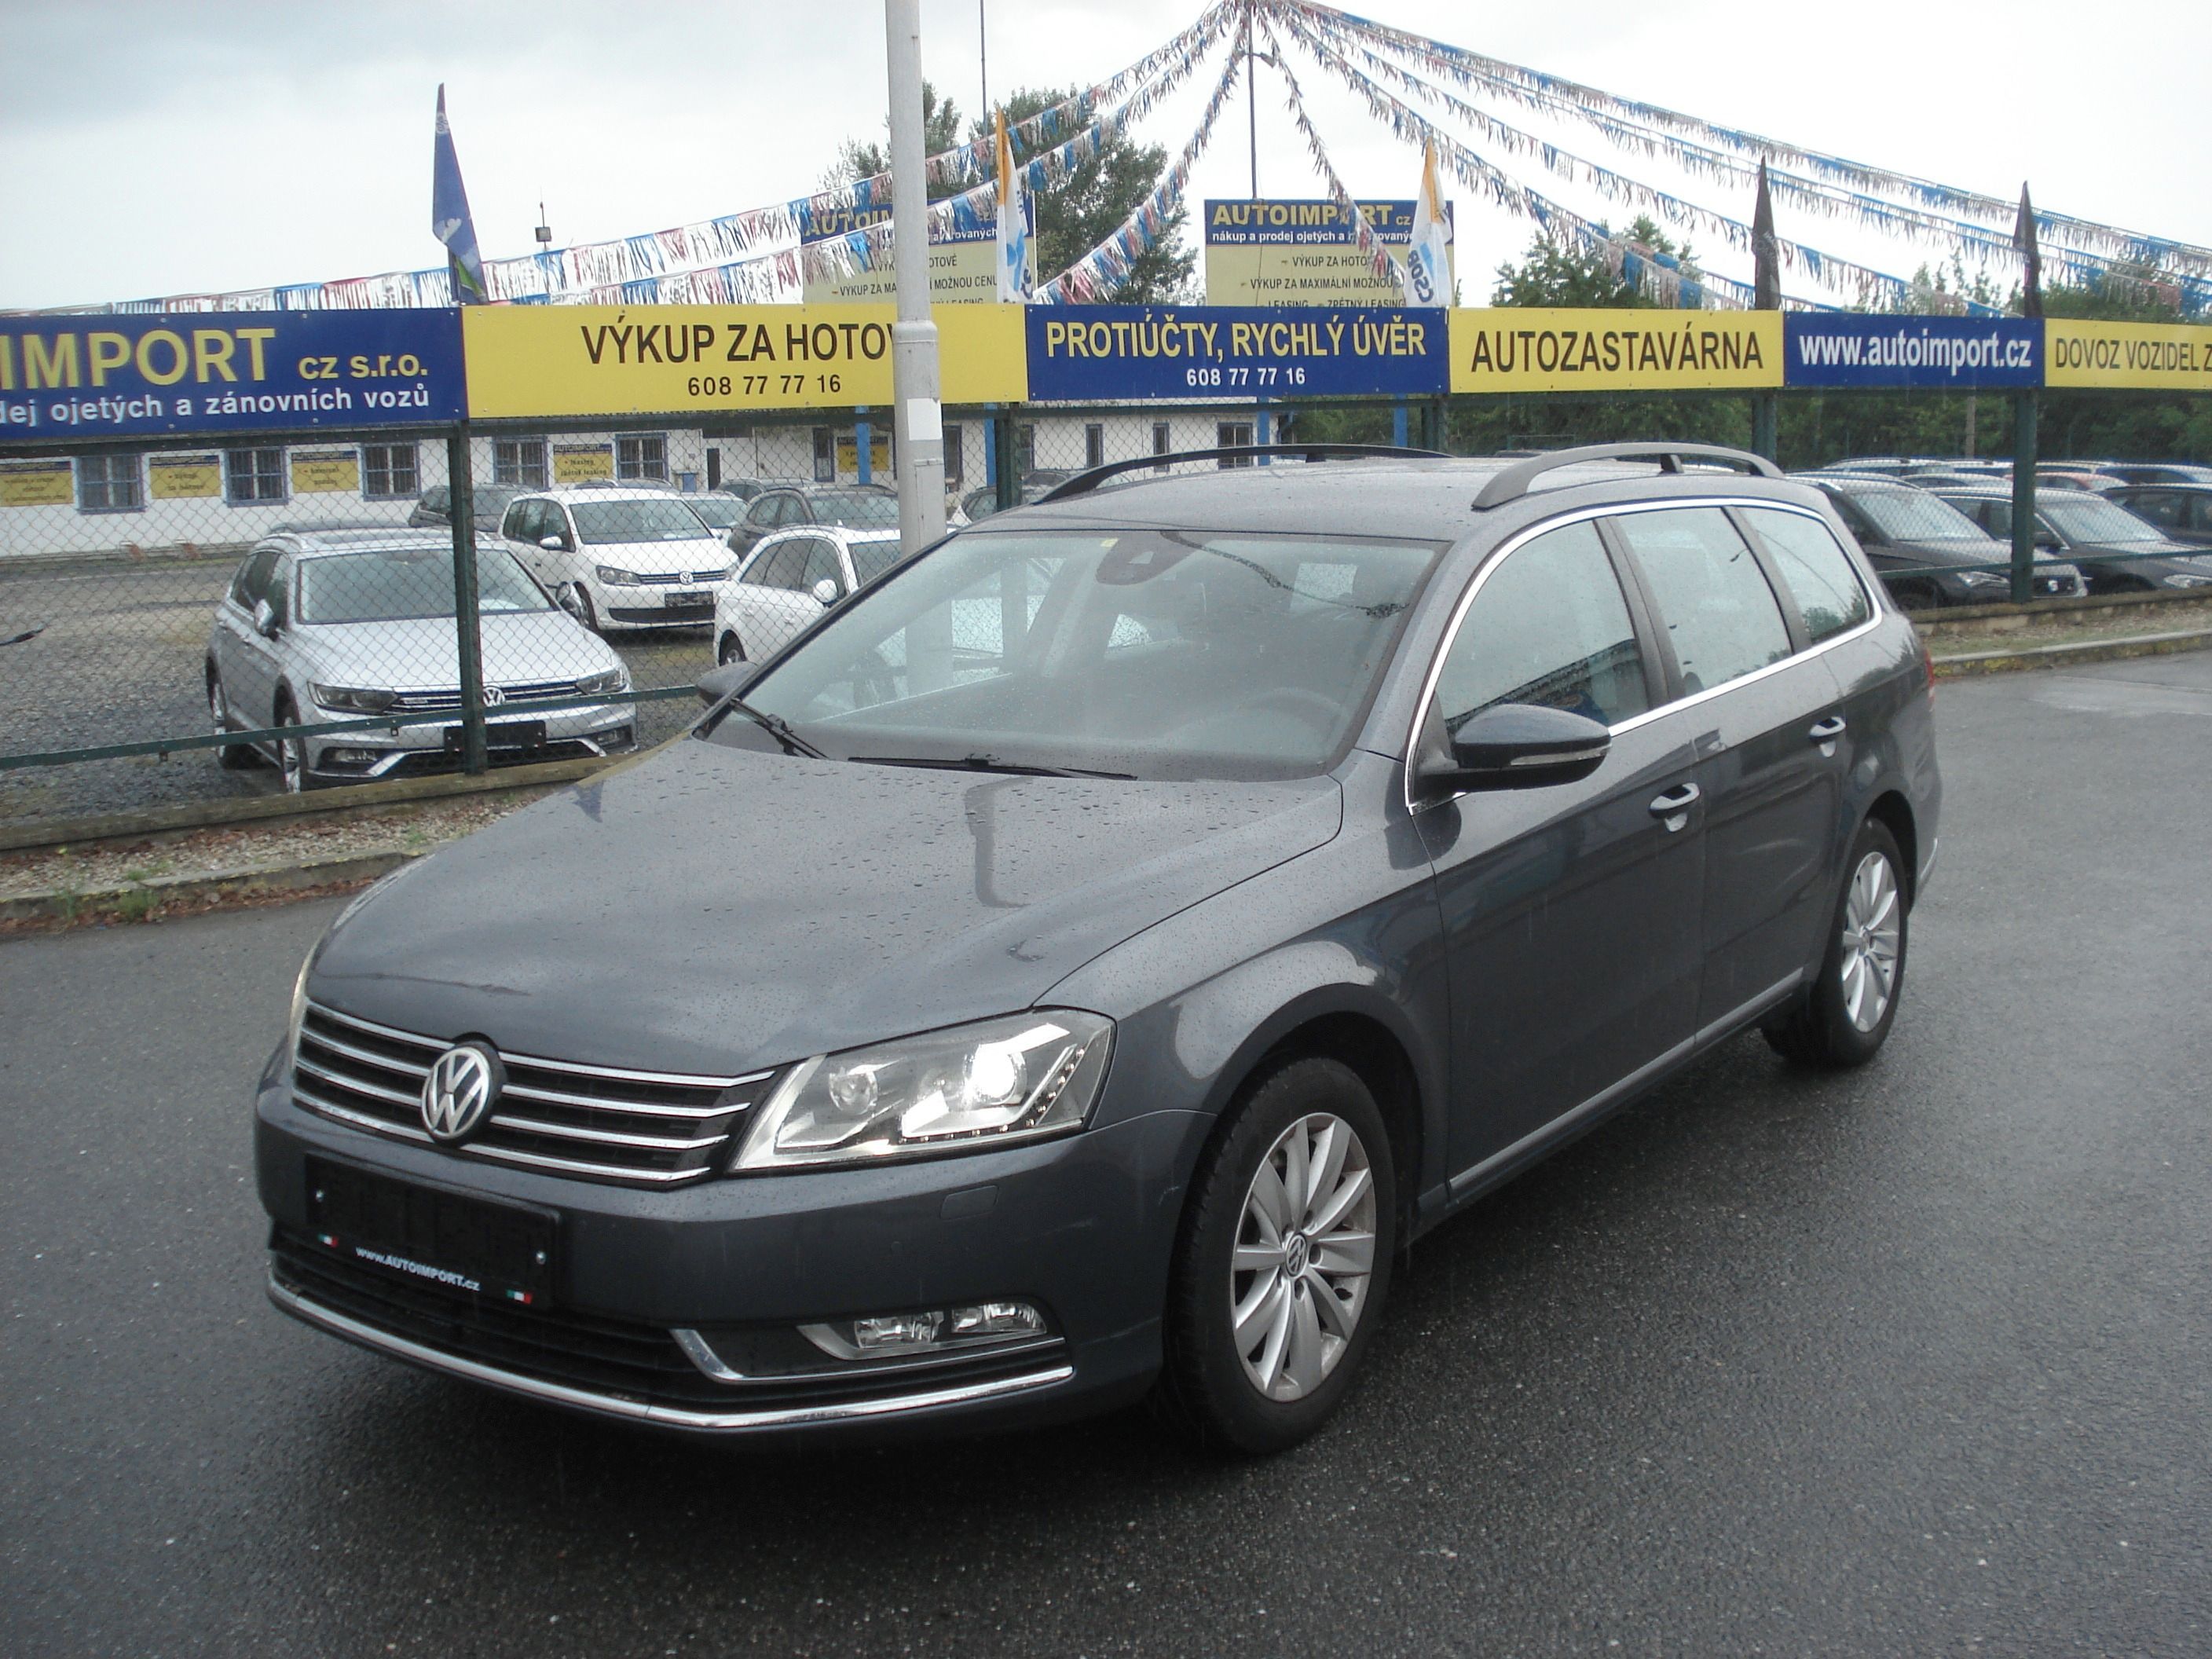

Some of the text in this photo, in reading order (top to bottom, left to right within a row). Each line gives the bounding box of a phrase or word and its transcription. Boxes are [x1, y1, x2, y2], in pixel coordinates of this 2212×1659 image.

[1212, 204, 1412, 225] AUTOIMPRT cz
[1212, 231, 1247, 244] nákup
[1259, 231, 1294, 244] prodej
[1296, 230, 1335, 244] ojetých
[1292, 254, 1368, 267] VÝKUP ZA HOTO
[870, 284, 883, 295] ZA
[935, 276, 972, 290] MOŽNOU
[1284, 278, 1298, 289] ZA
[1300, 276, 1351, 289] MAXIMÁLNÍ
[580, 315, 715, 364] VÝKUP
[727, 324, 776, 362] ZA
[1046, 313, 1427, 363] PROTIÚČTY, RYCHLÝ ÚVĚR
[1470, 321, 1764, 373] AUTOZASTAVÁRNA
[1798, 327, 2033, 377] www.autoimport.cz
[2056, 338, 2121, 369] DOVOZ
[2125, 340, 2200, 372] VOZIDEL
[298, 356, 339, 379] cz
[350, 354, 428, 379] s.r.o.
[1186, 367, 1306, 386] 608 77 77 16
[688, 374, 841, 396] 608 77 77 16
[51, 394, 163, 426] ojetých
[176, 397, 193, 416] a
[205, 387, 353, 416] zánovních
[364, 383, 430, 409] vozů
